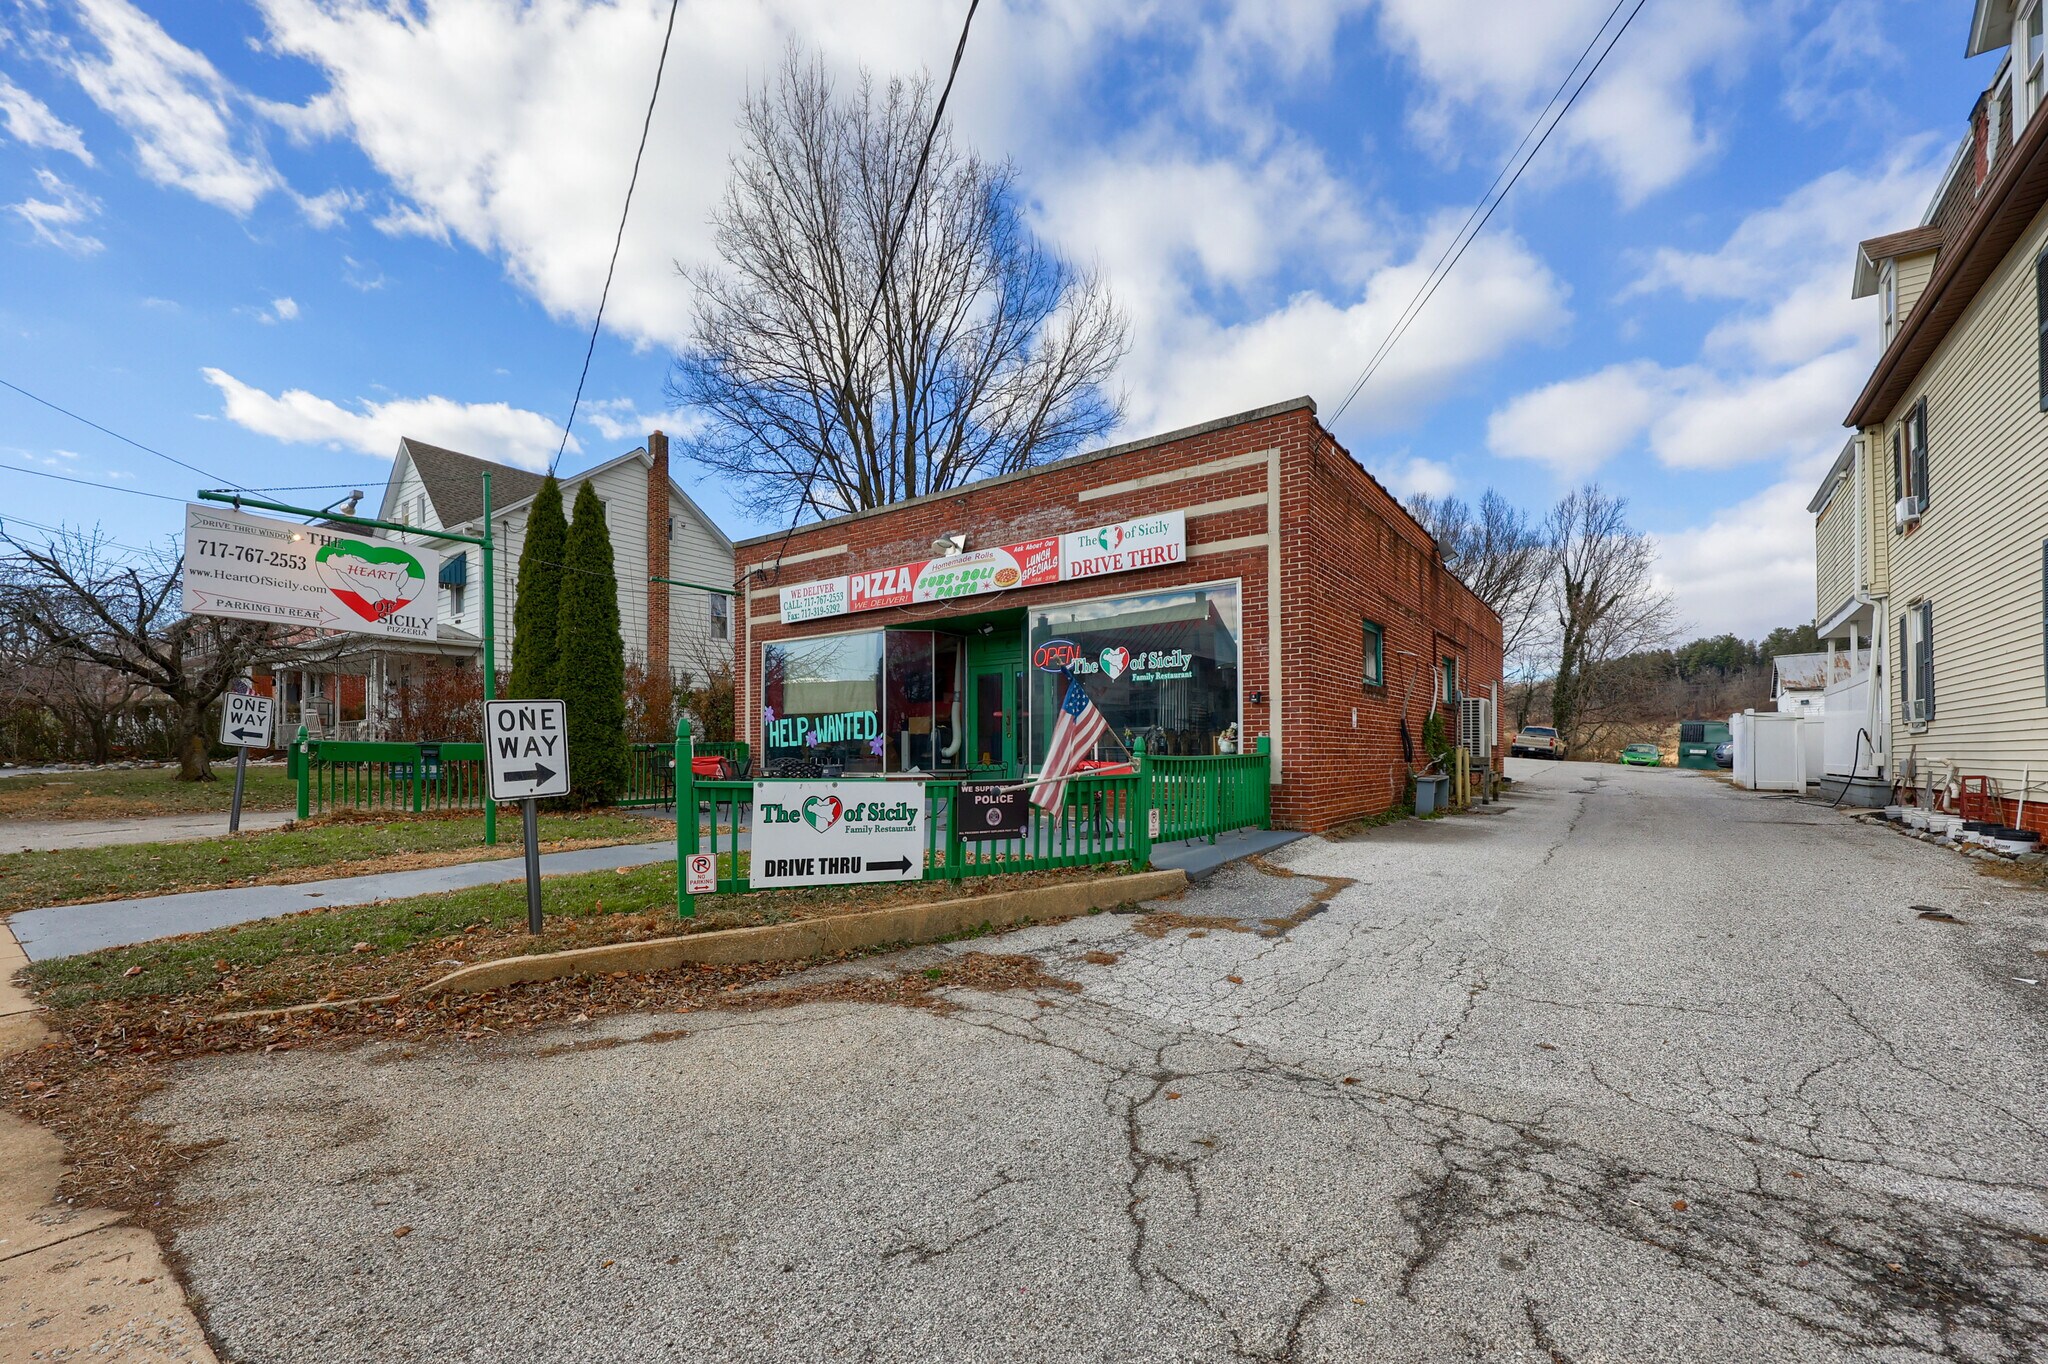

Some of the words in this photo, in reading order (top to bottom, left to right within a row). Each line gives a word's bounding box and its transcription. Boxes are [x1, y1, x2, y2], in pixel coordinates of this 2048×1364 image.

[202, 519, 230, 529] DRIVE
[233, 524, 257, 534] THRU
[259, 529, 294, 540] WINDOW
[1078, 535, 1097, 548] The
[1125, 525, 1136, 539] of
[1138, 521, 1170, 535] Sicily
[306, 532, 345, 550] THE
[1026, 542, 1043, 550] About
[198, 539, 307, 570] 717-767-2553
[932, 554, 972, 571] Homemade
[974, 551, 994, 560] Rolls
[1026, 548, 1050, 568] LUNCH
[1071, 554, 1124, 578] DRIVE
[1127, 543, 1180, 568] THRU
[348, 564, 398, 580] HEART
[918, 573, 955, 589] SUBS
[960, 567, 995, 582] BOLI
[1022, 556, 1058, 580] SPECIALS
[189, 568, 327, 594] www.HeartOfSicily.com
[791, 589, 802, 599] WE
[804, 583, 835, 597] DELIVER
[852, 567, 912, 600] PIZZA
[935, 581, 978, 598] PASTA
[216, 599, 271, 613] PARKING
[274, 606, 286, 614] IN
[288, 608, 320, 619] REAR
[373, 600, 395, 615] OF
[784, 600, 803, 610] CALL:
[804, 592, 844, 607] 717-767-2553
[854, 601, 868, 609] WE
[871, 595, 908, 607] DELIVER!
[376, 612, 434, 630] SICILY
[787, 611, 800, 620] Fax:
[801, 603, 841, 618] 717-319-5292
[386, 626, 427, 636] PIZZERIA
[1034, 645, 1080, 668] OPEN
[1072, 657, 1098, 674] The
[1129, 652, 1146, 670] of
[1149, 649, 1193, 672] Sicily
[1132, 673, 1154, 682] Family
[1155, 670, 1193, 680] Restaurant
[232, 698, 267, 713] ONE
[231, 711, 267, 726] WAY
[498, 709, 556, 731] ONE
[769, 716, 809, 748] HELP
[815, 711, 878, 743] WANTED
[498, 735, 558, 759] WAY
[974, 794, 1014, 804] POLICE
[760, 804, 800, 823] The
[844, 803, 866, 822] of
[867, 802, 919, 825] Sicily
[845, 825, 873, 835] Family
[875, 825, 917, 833] Restaurant
[764, 858, 814, 878] DRIVE
[820, 857, 862, 875] THRU
